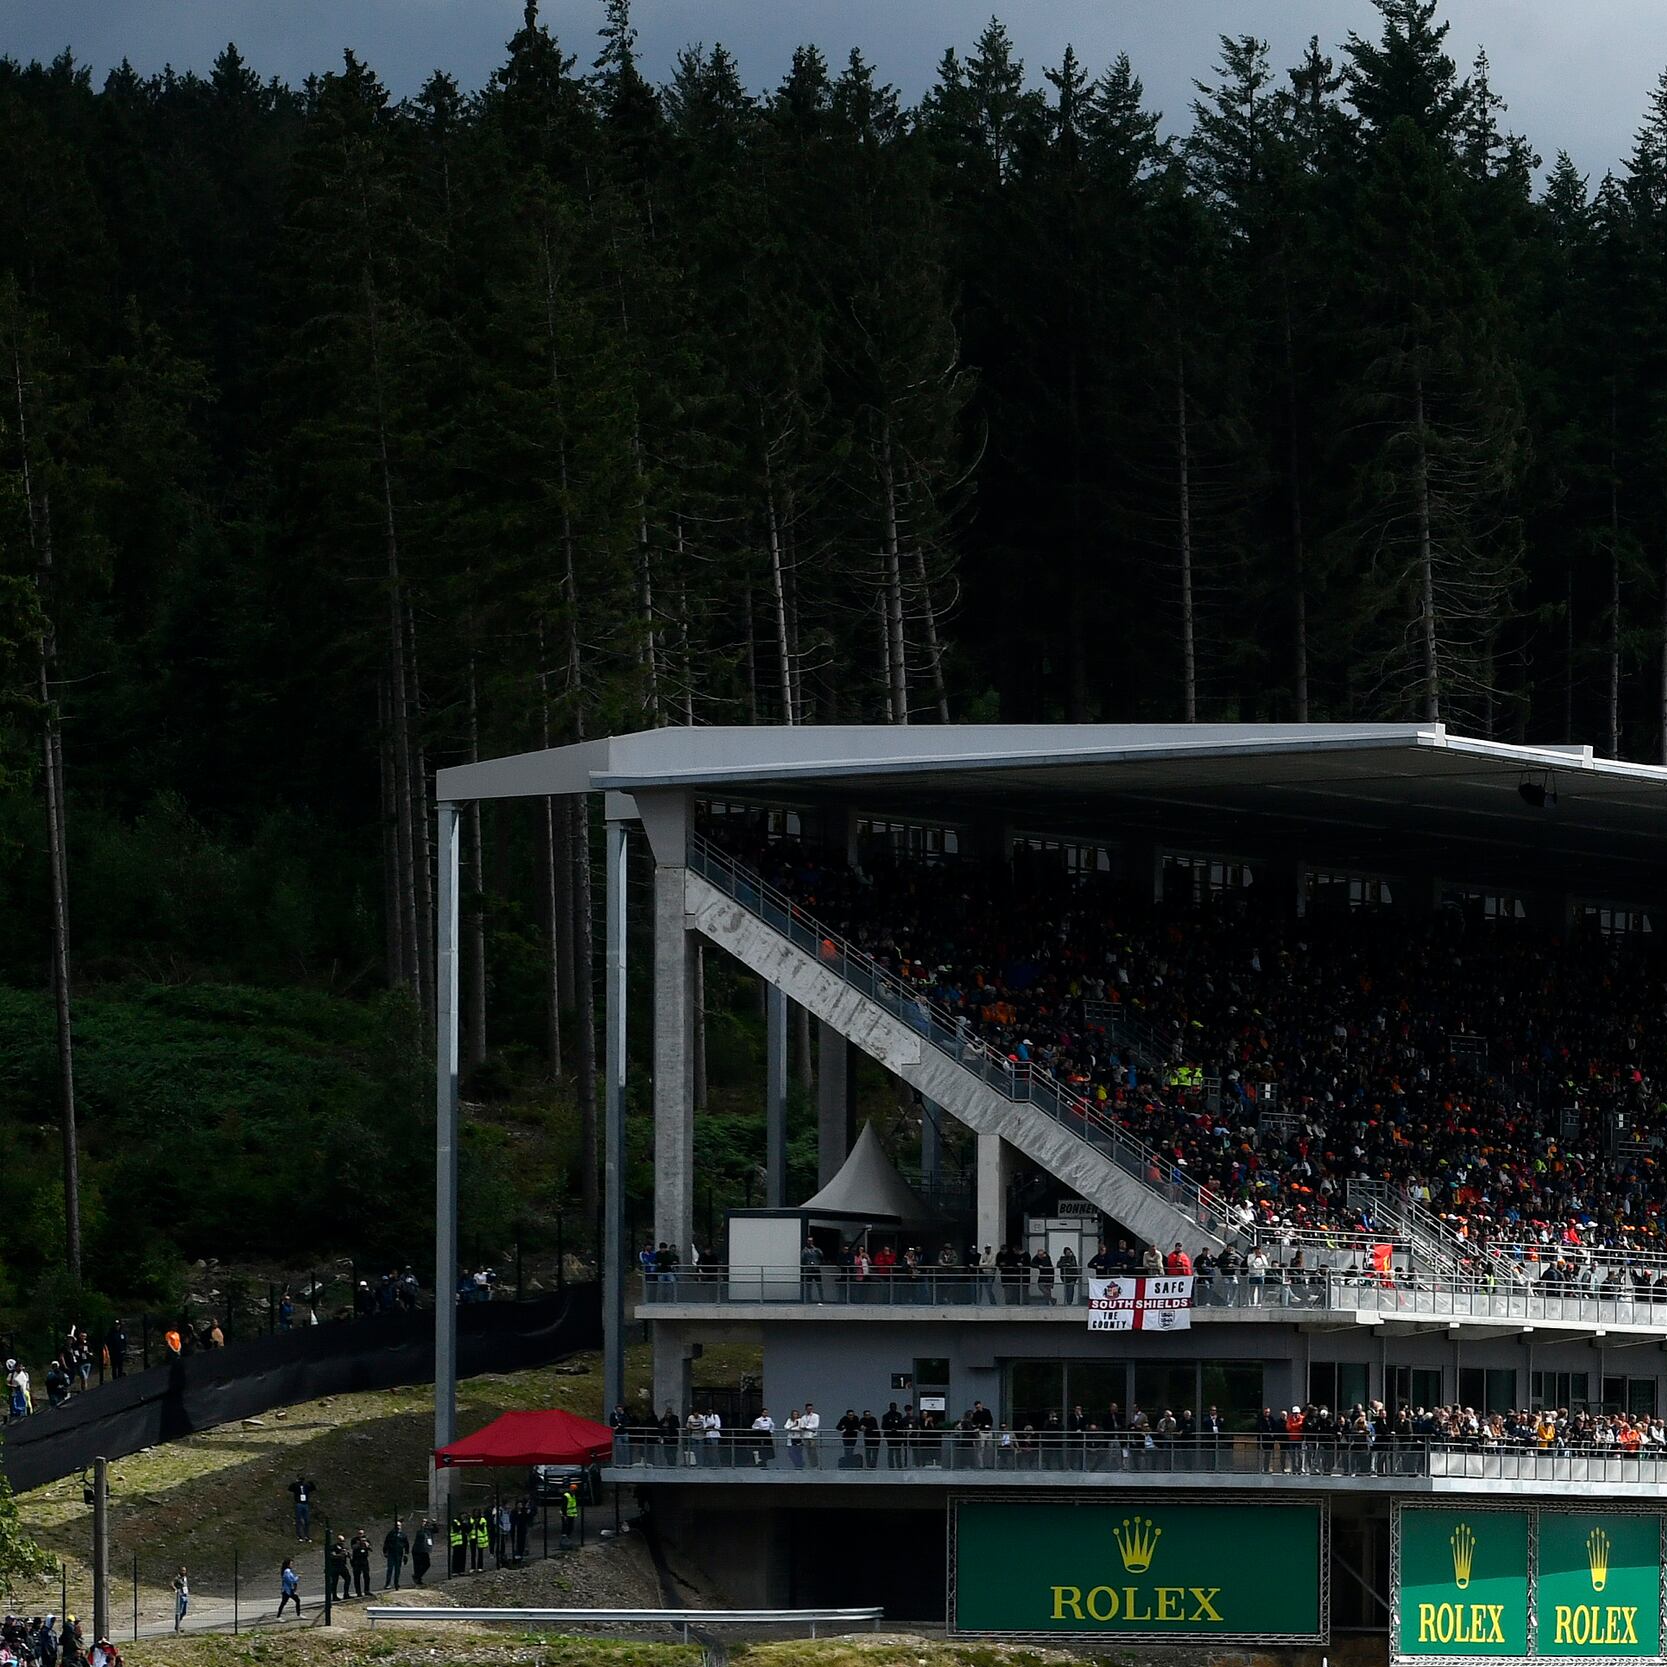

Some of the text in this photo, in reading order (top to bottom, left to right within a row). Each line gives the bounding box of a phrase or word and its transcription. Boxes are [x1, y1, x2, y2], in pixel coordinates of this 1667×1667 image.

[1154, 1281, 1185, 1294] SAFC
[1091, 1298, 1188, 1309] SOUTH SHIELDS
[1103, 1312, 1118, 1320] THE
[1092, 1320, 1127, 1329] COUNTY
[1051, 1586, 1223, 1621] ROLEX
[1419, 1603, 1505, 1643] ROLEX
[1554, 1605, 1637, 1644] ROLEX
